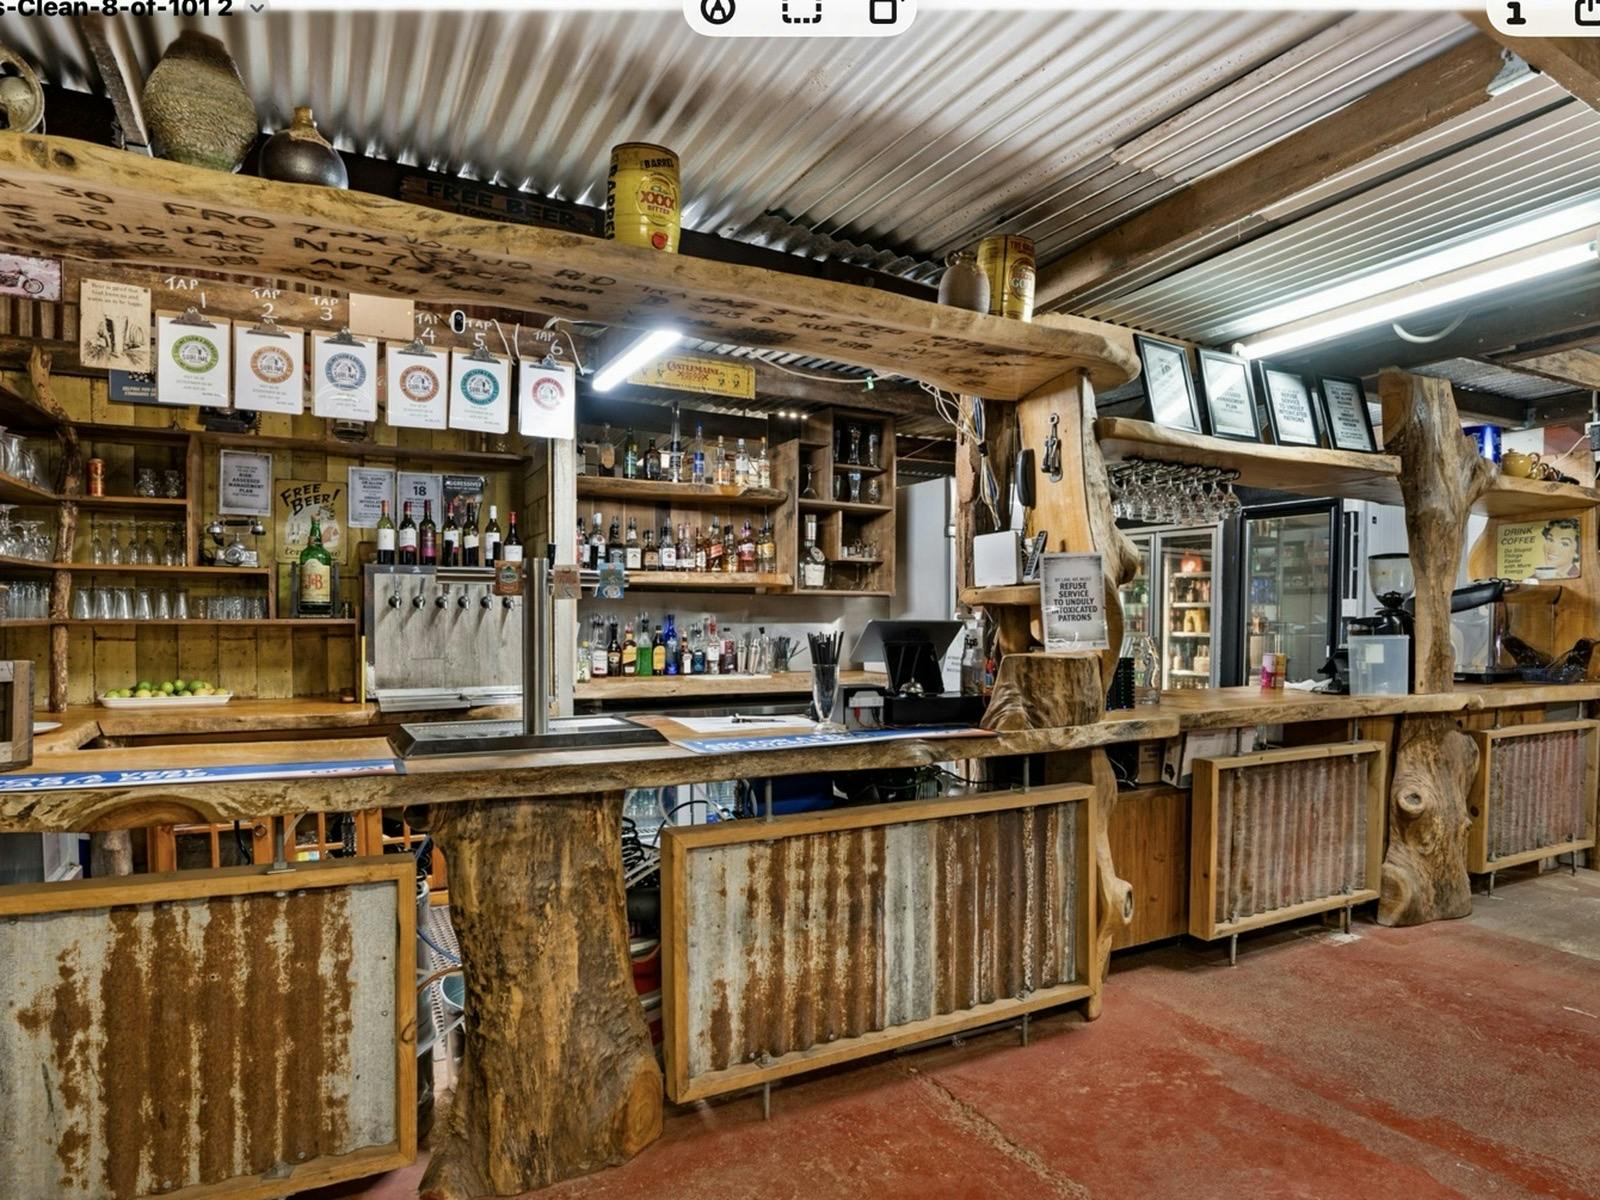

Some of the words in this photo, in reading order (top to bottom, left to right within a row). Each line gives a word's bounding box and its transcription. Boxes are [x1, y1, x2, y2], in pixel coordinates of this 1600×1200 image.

[53, 213, 169, 240] 2012
[165, 276, 198, 291] TAP
[251, 288, 281, 299] TAP
[201, 292, 206, 309] 1
[310, 296, 339, 307] TAP
[261, 303, 279, 319] 2
[320, 308, 333, 321] 3
[416, 313, 440, 326] TAP
[467, 320, 493, 331] TAP
[421, 327, 437, 345] 4
[473, 333, 487, 348] 5
[533, 330, 556, 342] TAP
[551, 339, 564, 356] 6
[280, 483, 321, 507] FREE
[413, 486, 427, 496] 18
[290, 489, 341, 516] BEER!
[1504, 526, 1533, 537] DRINK
[1500, 536, 1536, 546] COFFEE
[1059, 582, 1087, 590] REFUSE
[1058, 590, 1089, 598] SERVICE
[1065, 598, 1095, 606] UNDULY
[1058, 614, 1092, 622] PATRONS
